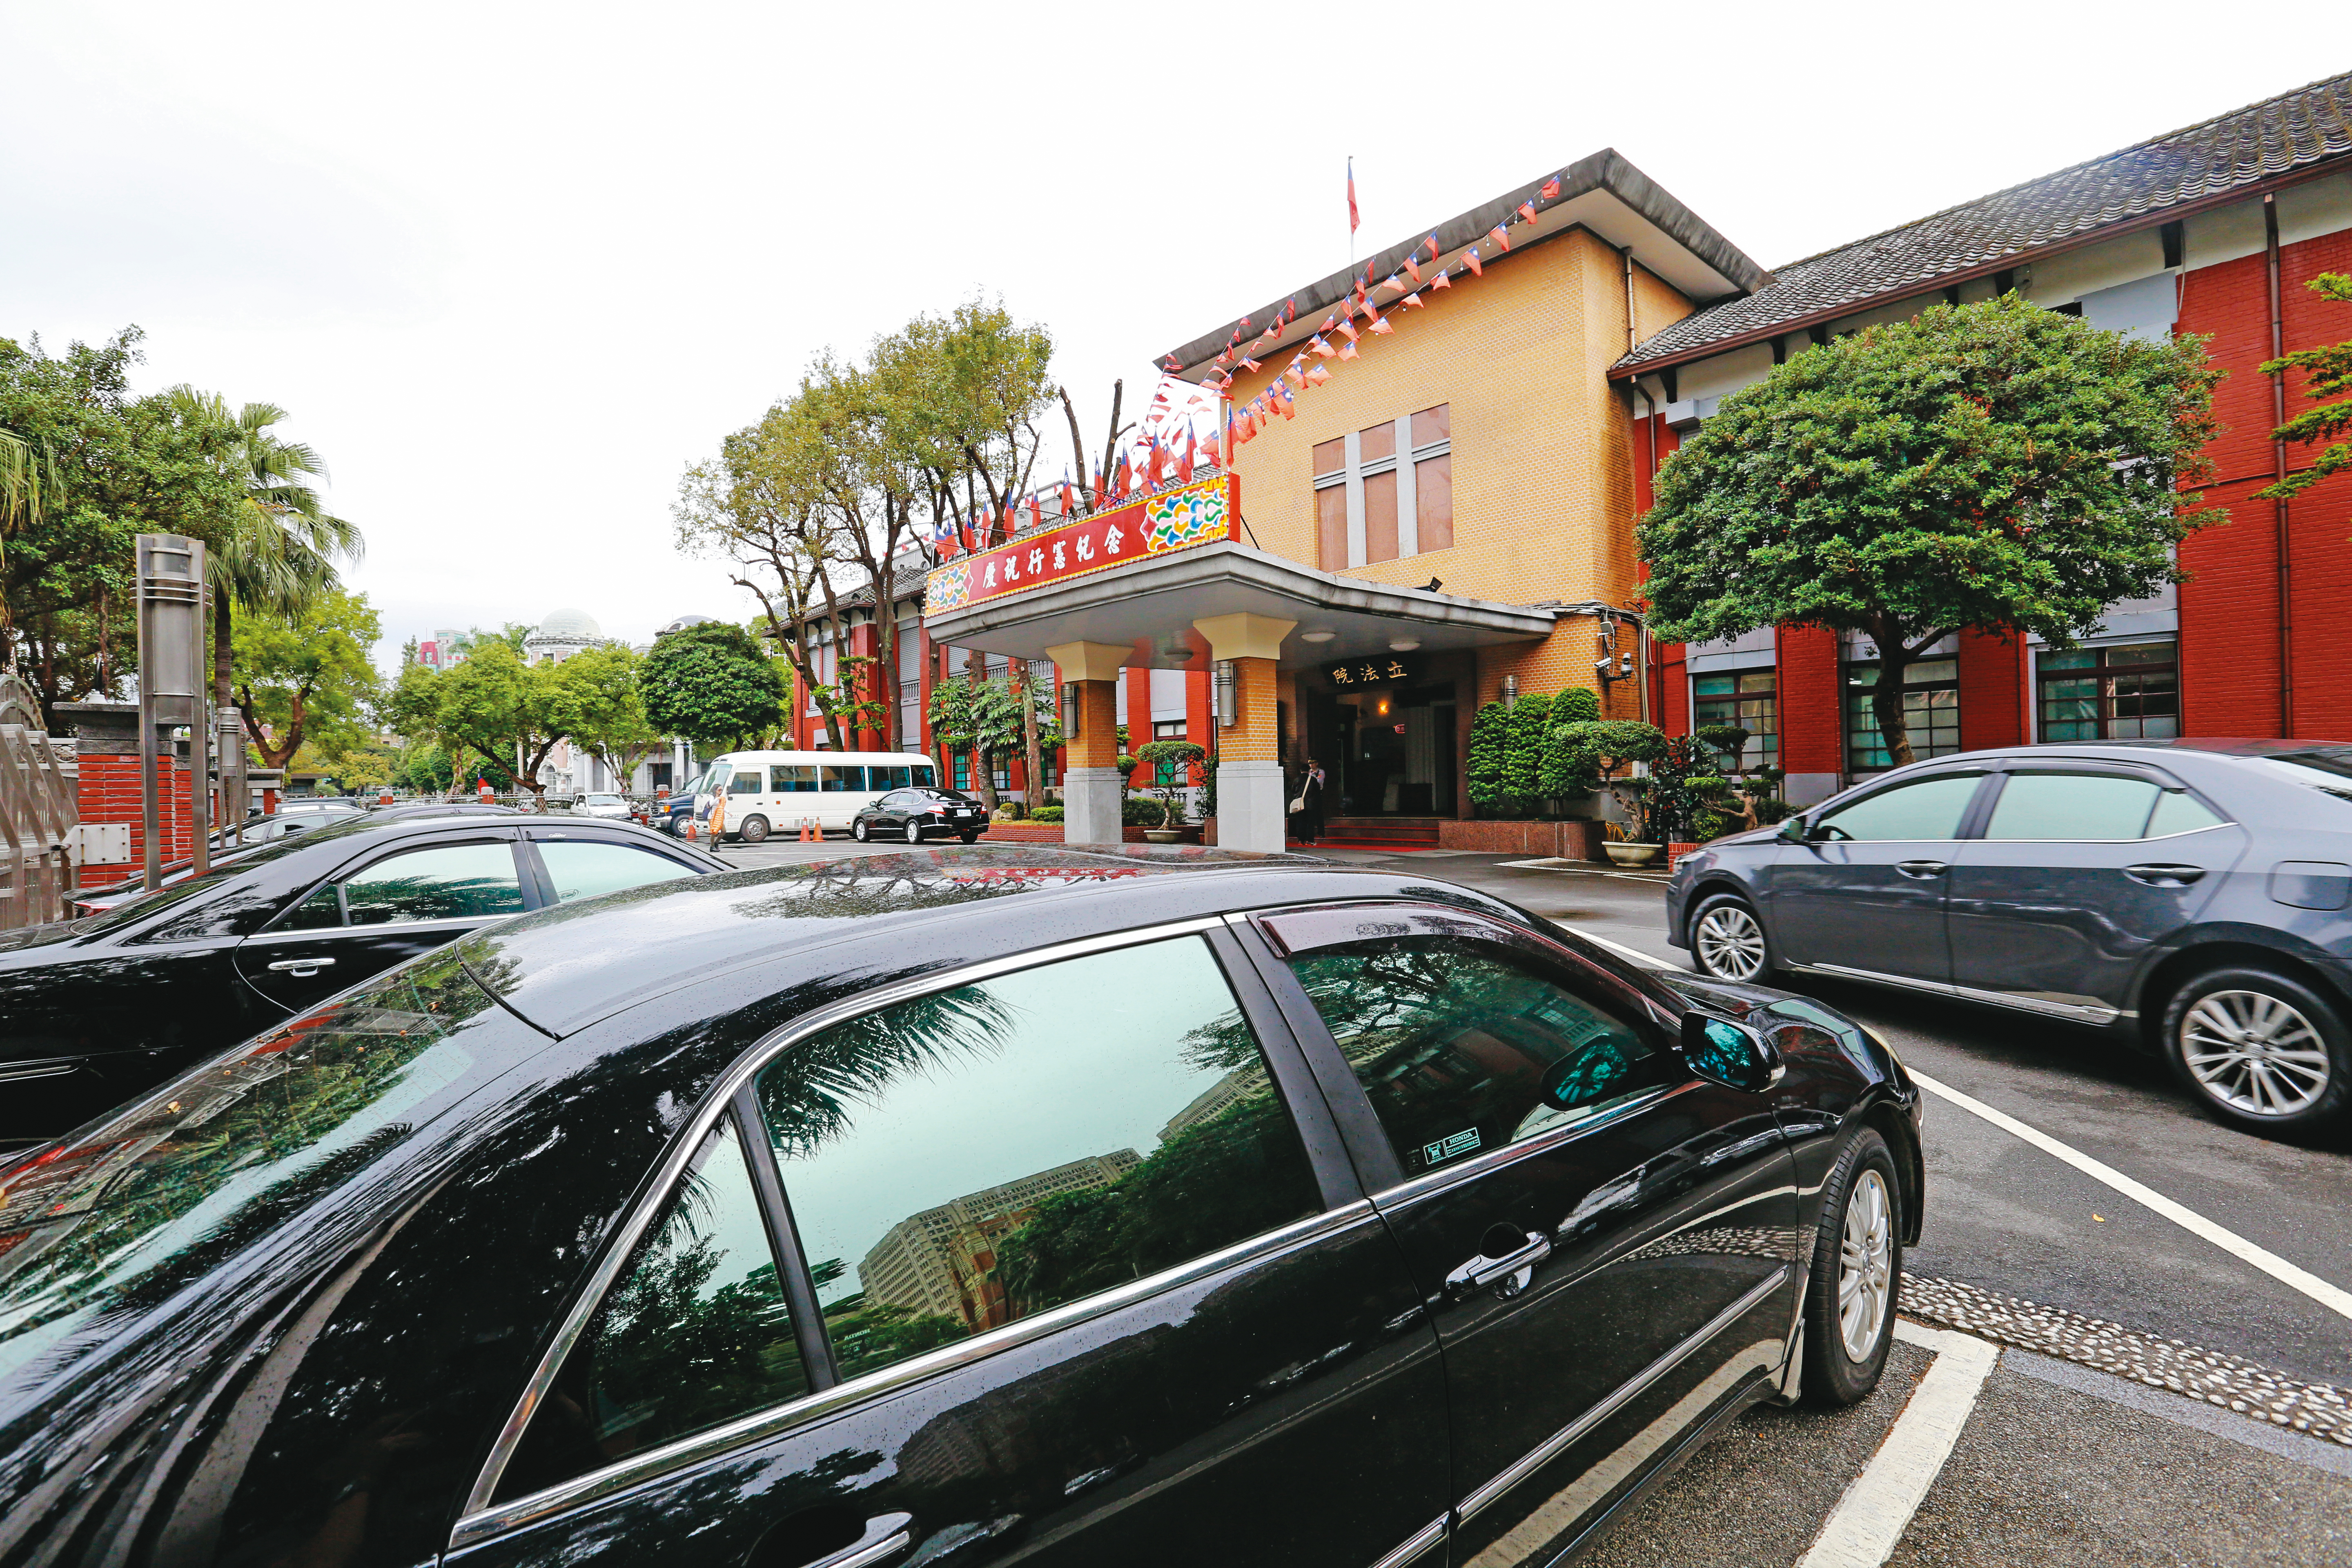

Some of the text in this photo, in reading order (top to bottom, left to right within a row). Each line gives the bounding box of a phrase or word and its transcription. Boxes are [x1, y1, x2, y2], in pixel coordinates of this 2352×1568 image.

[982, 523, 1125, 589] 慶祝行憲紀念
[1449, 1132, 1473, 1145] HONDA
